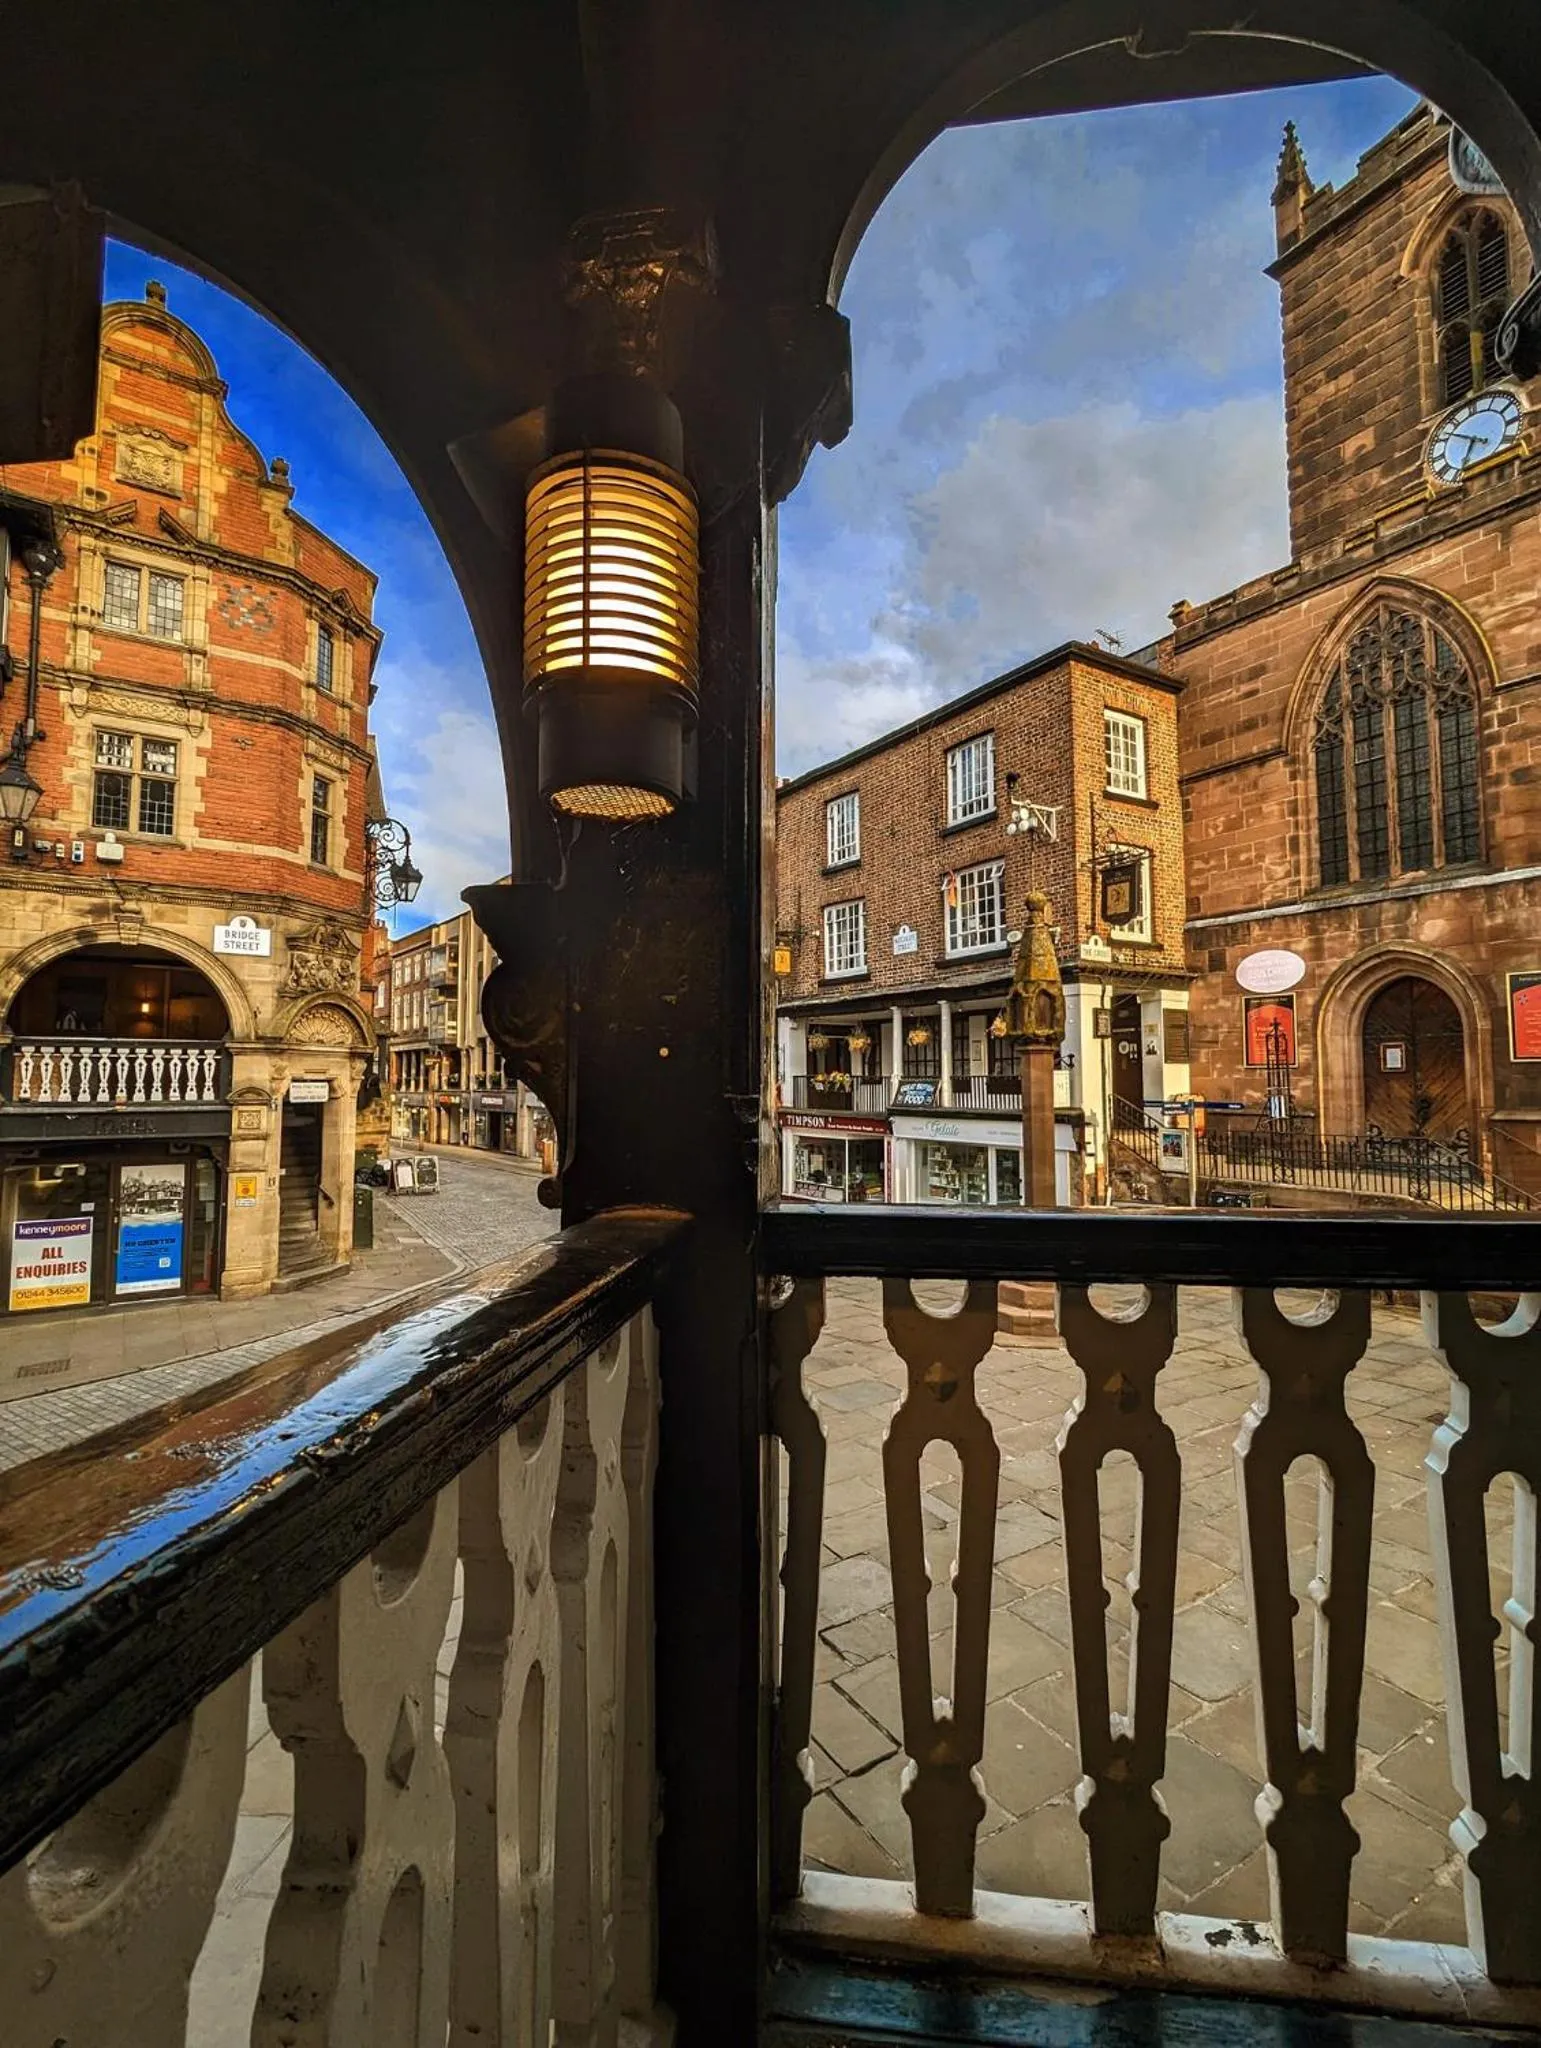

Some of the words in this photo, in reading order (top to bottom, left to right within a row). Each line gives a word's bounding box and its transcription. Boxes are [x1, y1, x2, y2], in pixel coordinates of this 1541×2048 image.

[224, 929, 261, 941] BRIDGE
[223, 940, 261, 951] STREET
[787, 1114, 826, 1128] TIMPSON
[19, 1223, 87, 1236] kenneymoore
[41, 1246, 64, 1260] ALL
[15, 1261, 88, 1279] ENQUIRIES
